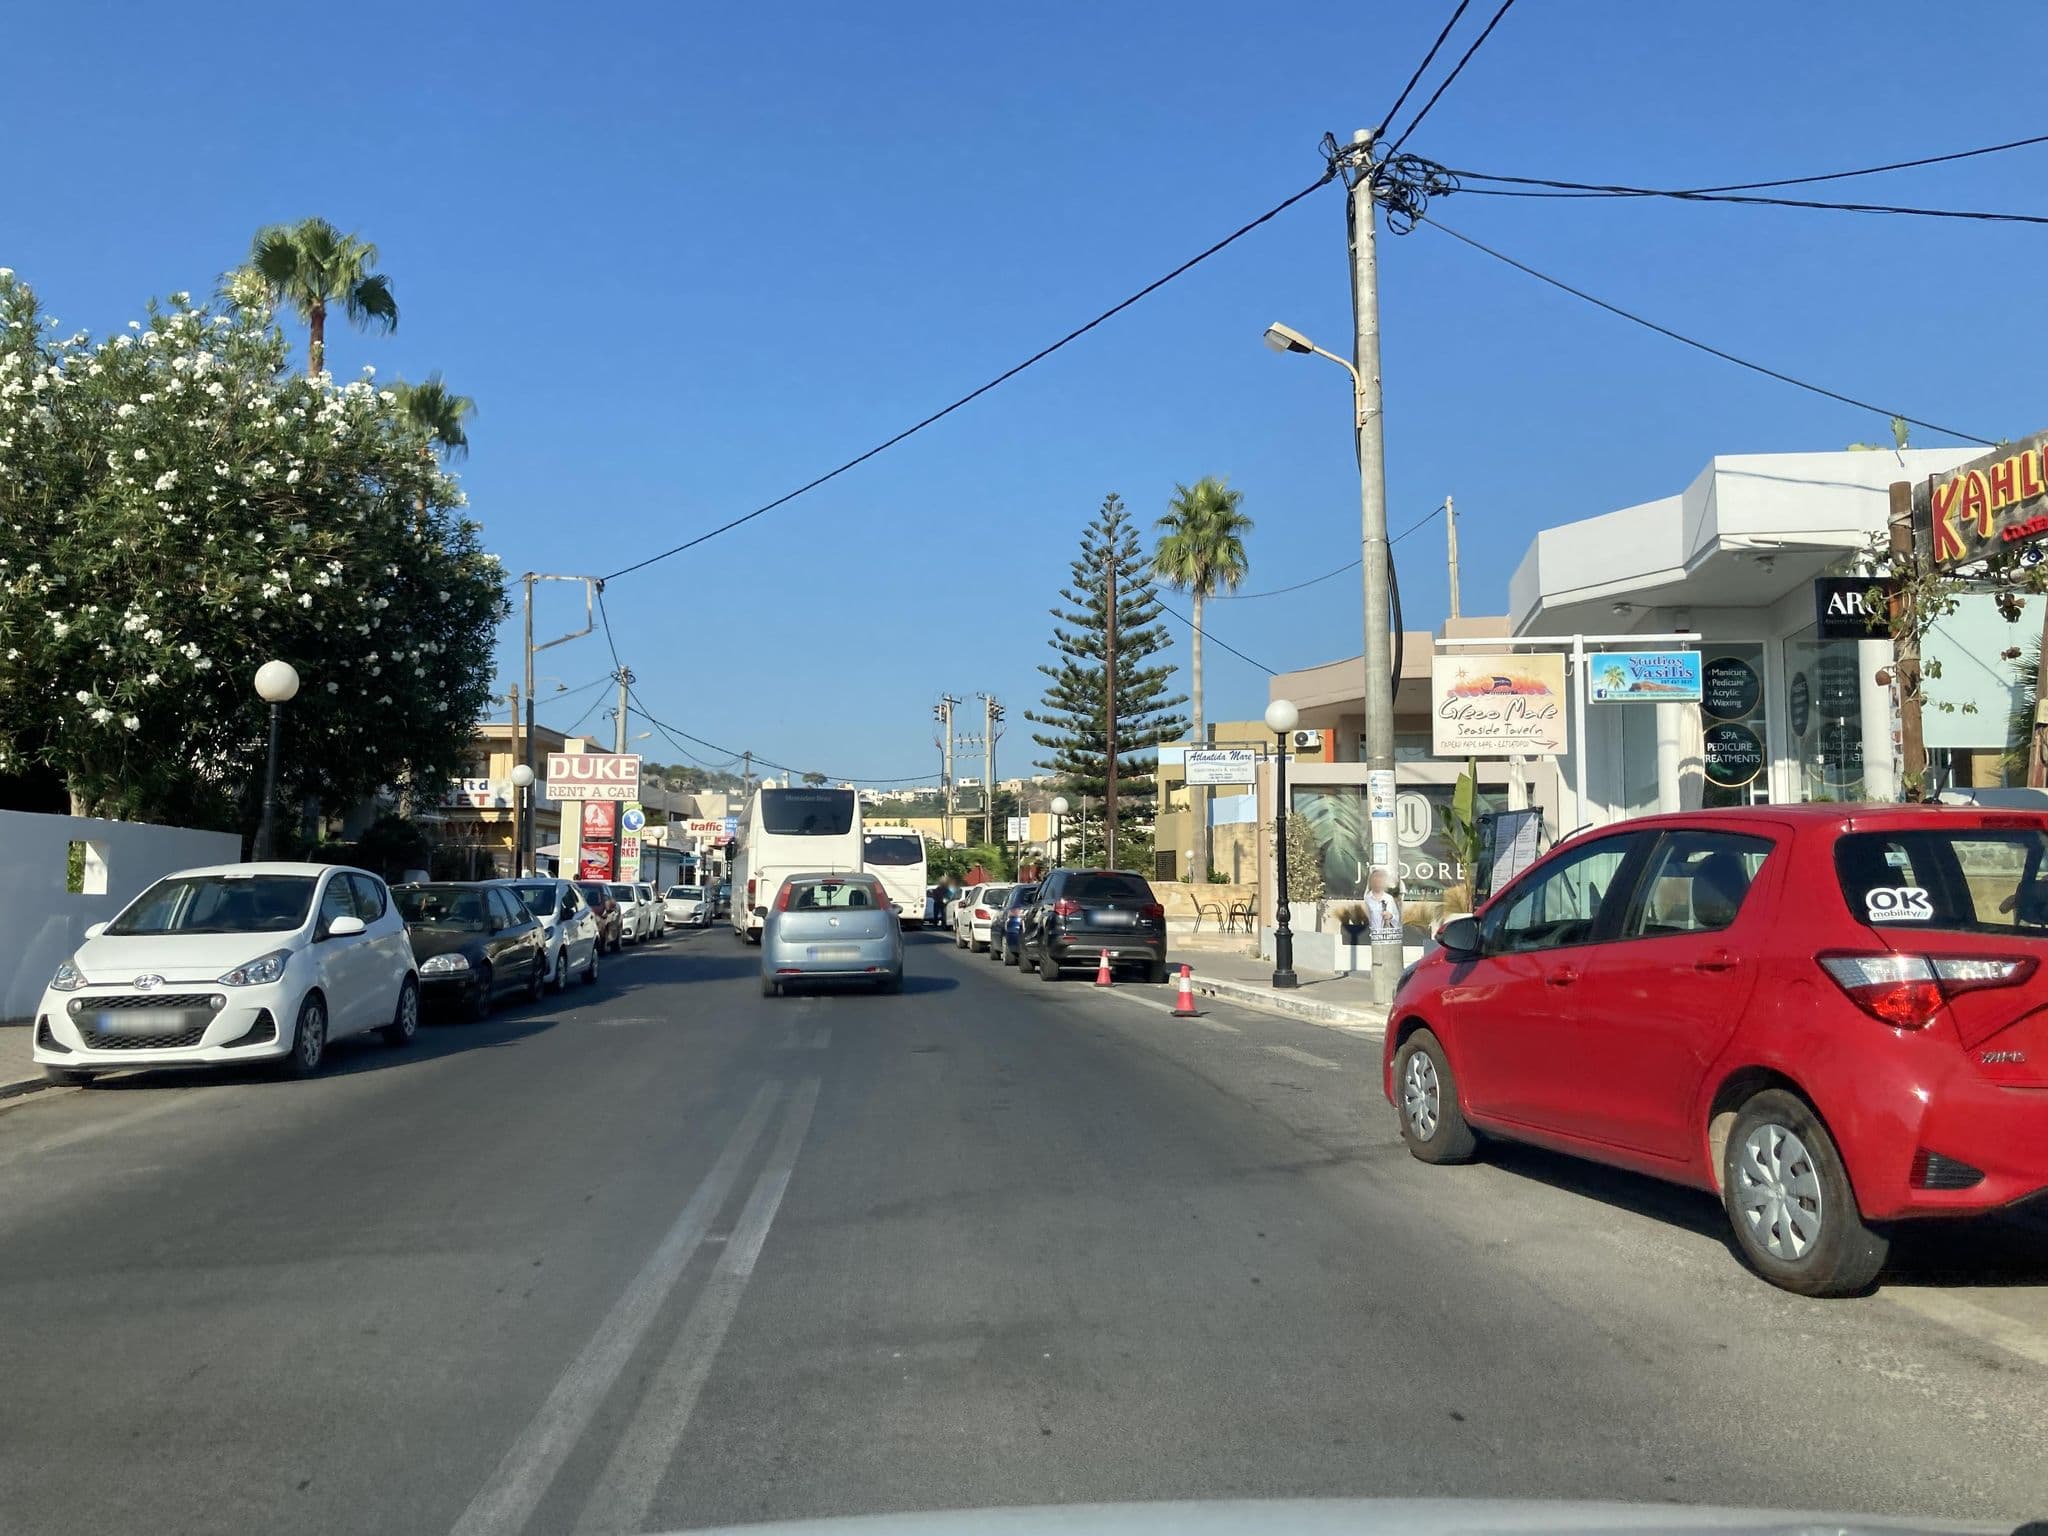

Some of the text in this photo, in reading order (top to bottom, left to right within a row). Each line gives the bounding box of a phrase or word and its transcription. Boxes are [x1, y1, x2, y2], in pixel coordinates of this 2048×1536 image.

[1932, 443, 2048, 562] KAHL
[1629, 656, 1683, 667] Studios
[1631, 666, 1693, 679] Vasilis
[1713, 690, 1740, 698] Acrylic
[1439, 696, 1558, 722] Greco Mare
[1712, 700, 1741, 708] Waxing
[1457, 723, 1543, 735] Seaside Tavern
[1720, 731, 1737, 740] SPA
[1707, 742, 1752, 751] PEDICURE
[1189, 750, 1252, 761] Atlantida Mare
[1705, 754, 1761, 763] REATMENTS
[549, 757, 637, 779] DUKE
[548, 786, 636, 798] RENT A CAR
[690, 821, 723, 832] traffic
[623, 837, 636, 846] PER
[1870, 891, 1927, 910] OK
[1873, 910, 1918, 919] mobility
